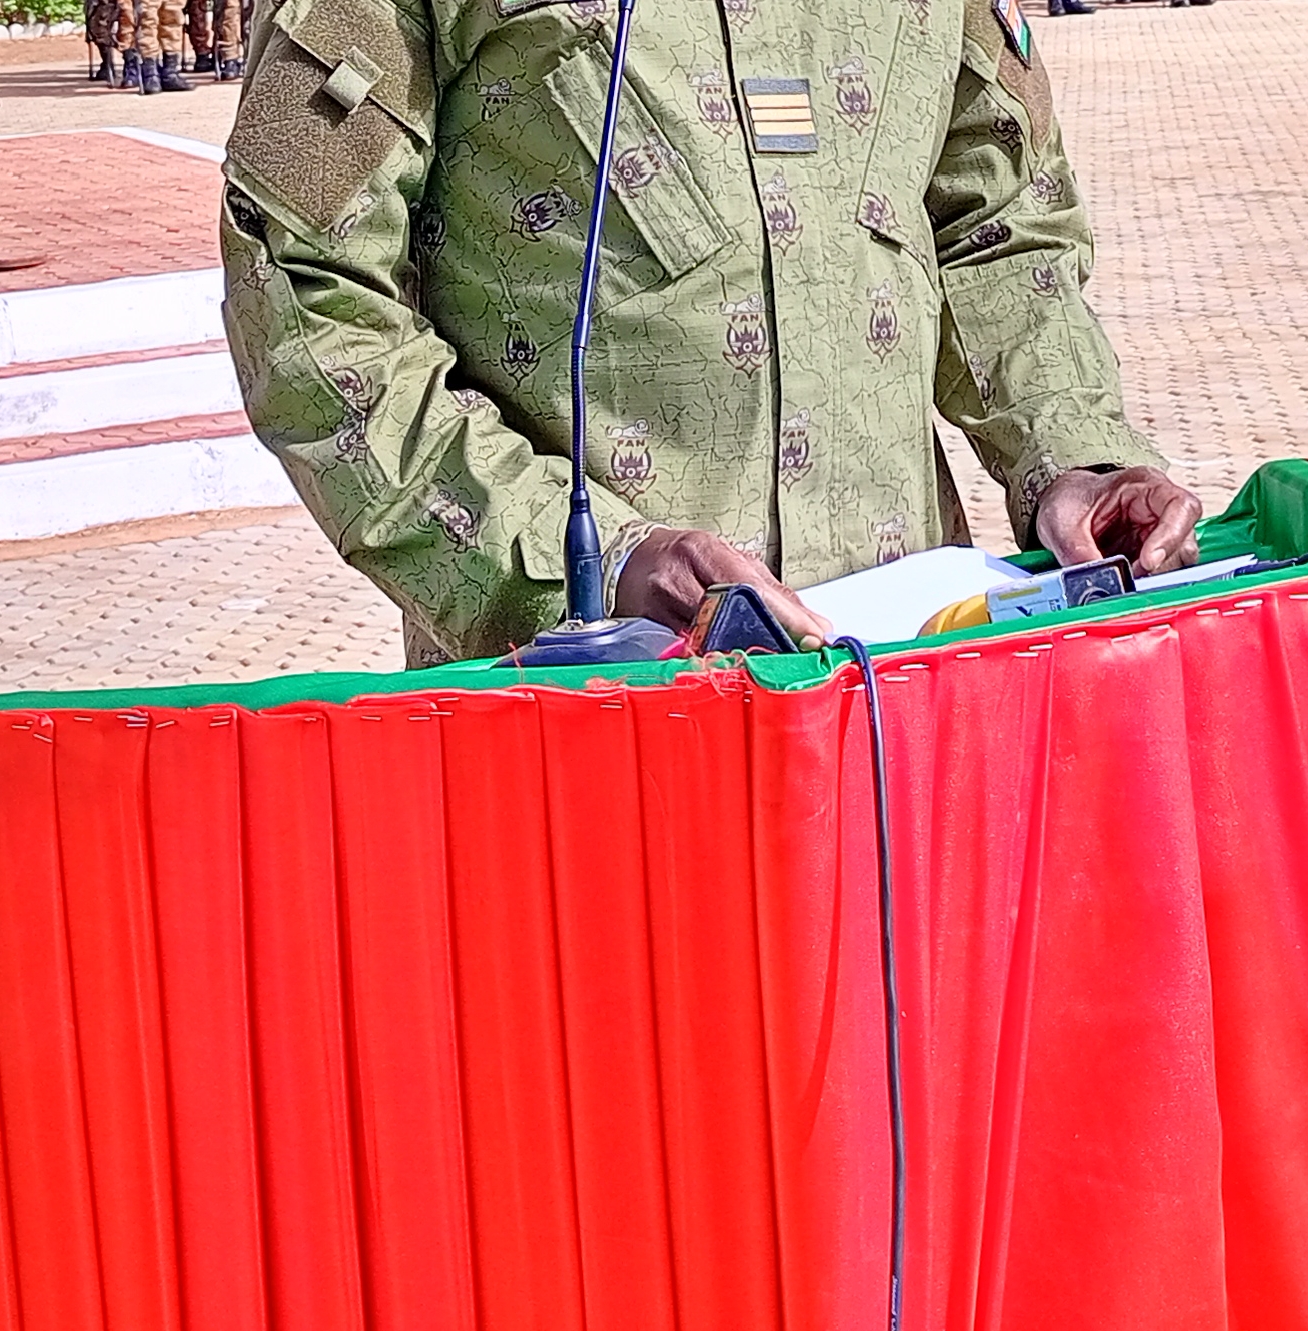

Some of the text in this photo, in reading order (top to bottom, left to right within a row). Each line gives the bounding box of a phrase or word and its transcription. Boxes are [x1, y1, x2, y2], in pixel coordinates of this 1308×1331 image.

[838, 76, 864, 85] FAN
[697, 87, 722, 95] FAN
[485, 97, 510, 105] FAN
[731, 314, 759, 322] FAN
[782, 430, 806, 438] FAN
[617, 439, 645, 447] FAN
[879, 534, 902, 542] FAN
